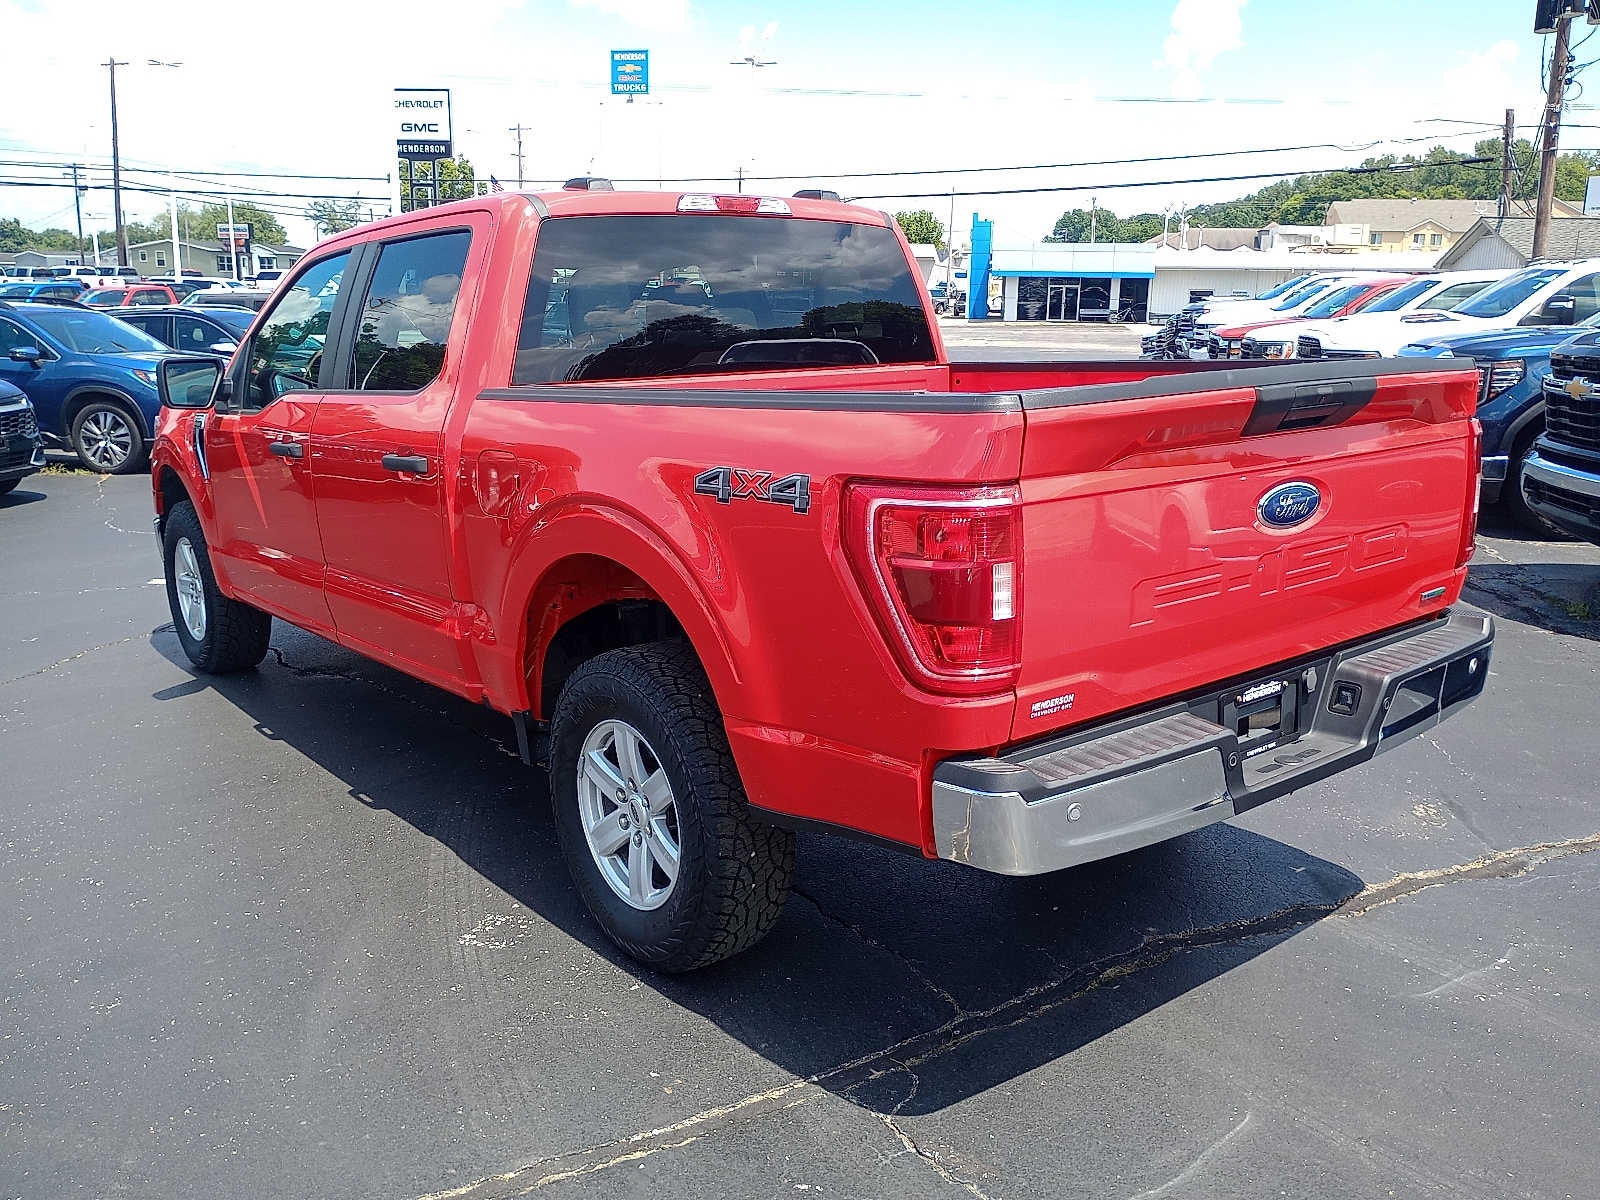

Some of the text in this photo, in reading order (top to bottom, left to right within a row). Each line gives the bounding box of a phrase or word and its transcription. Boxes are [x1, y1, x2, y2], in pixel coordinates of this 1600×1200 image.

[613, 53, 646, 61] HENDERSON
[613, 83, 647, 92] TRUCKS
[394, 100, 444, 109] CHEVROLET
[401, 123, 439, 133] GMC
[397, 144, 446, 154] HENDERSON
[1276, 491, 1319, 520] Ford
[1244, 683, 1282, 703] HENDERSON
[1031, 693, 1075, 712] HENDERSON
[1030, 706, 1061, 719] CHEVROLET
